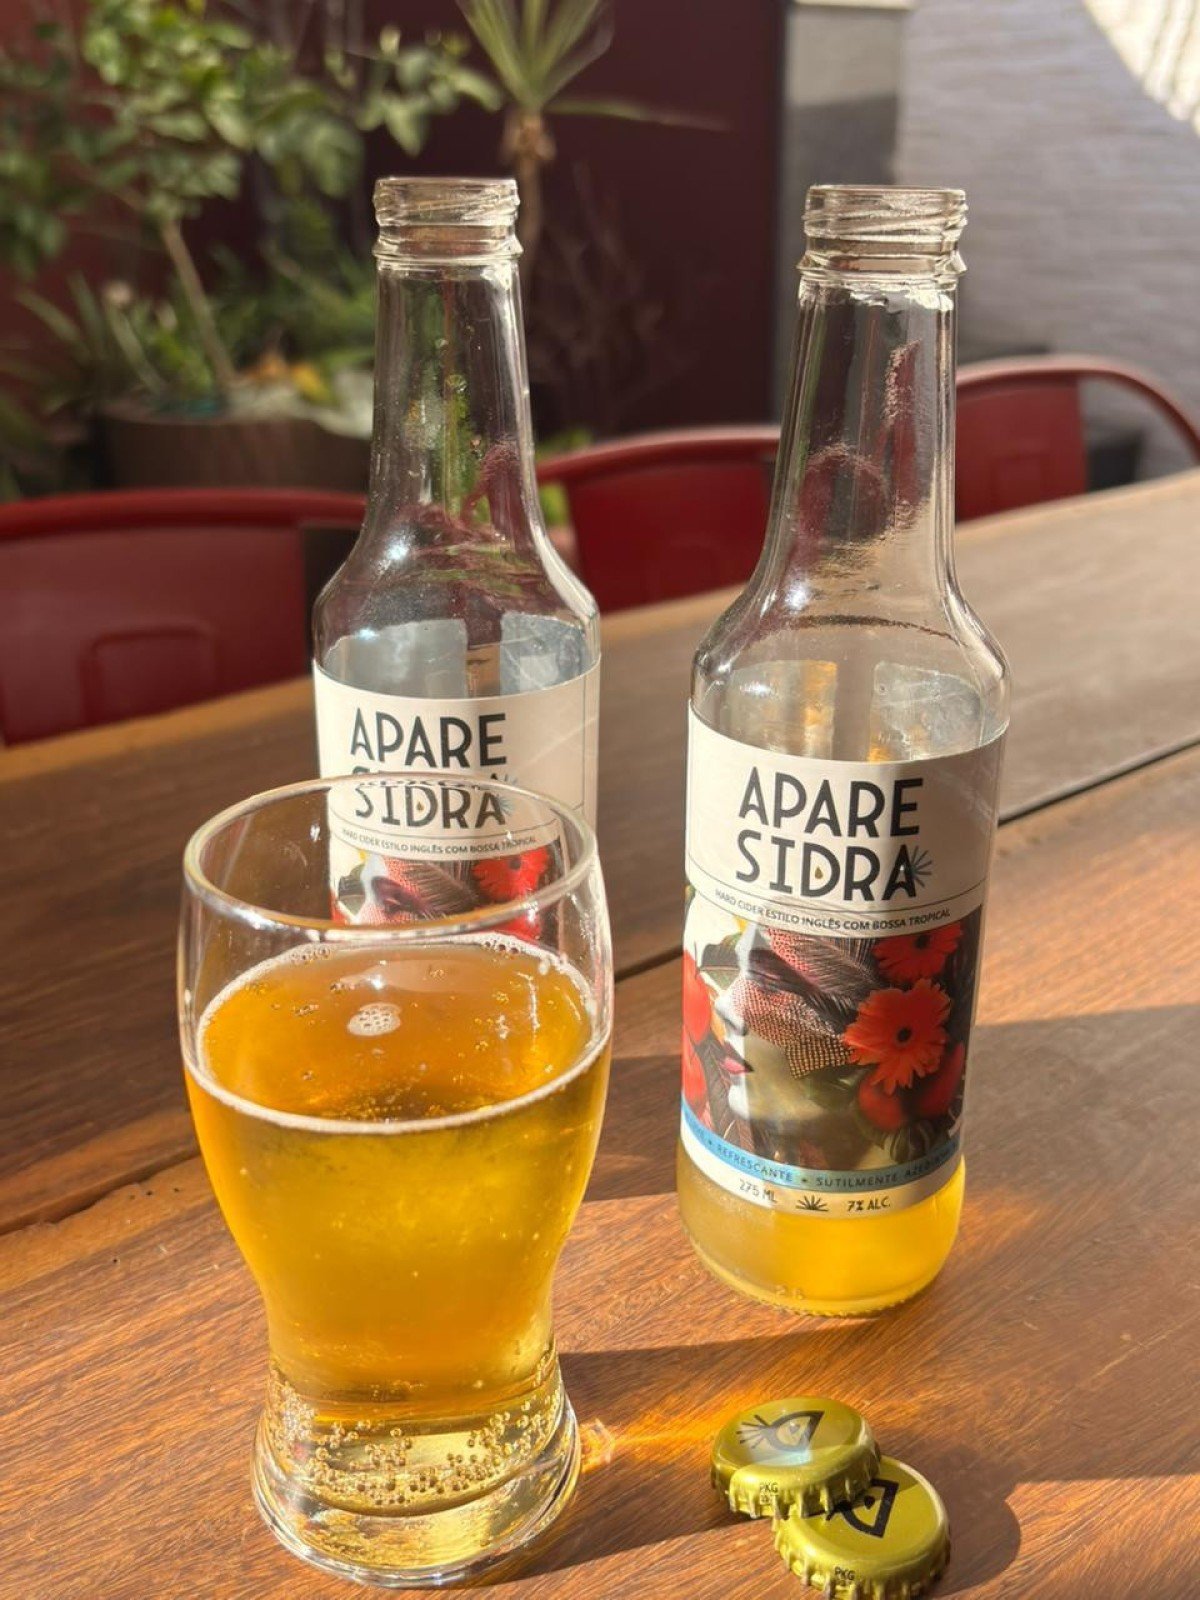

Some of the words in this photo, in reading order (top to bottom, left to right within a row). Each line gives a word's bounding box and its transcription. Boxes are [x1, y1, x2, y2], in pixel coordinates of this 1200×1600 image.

[351, 707, 507, 768] APARE
[353, 766, 506, 829] SIDRA
[738, 766, 924, 838] APARE
[445, 845, 467, 854] COM
[735, 829, 917, 901] SIDRA
[715, 888, 737, 906] HARD
[738, 899, 763, 917] CIDER
[765, 909, 800, 925] ESTILO
[801, 917, 841, 930] INGLÊS
[843, 920, 869, 931] COM
[872, 919, 906, 931] BOSSA
[909, 907, 951, 927] TROPICAL
[717, 1143, 793, 1182] REFRESCANTE
[815, 1173, 898, 1188] SUTILMENTE
[740, 1180, 760, 1197] 275
[762, 1189, 777, 1203] ML
[847, 1200, 864, 1212] 7%
[867, 1196, 890, 1210] ALC.
[760, 1482, 778, 1494] PKG
[834, 1566, 855, 1581] PKG
